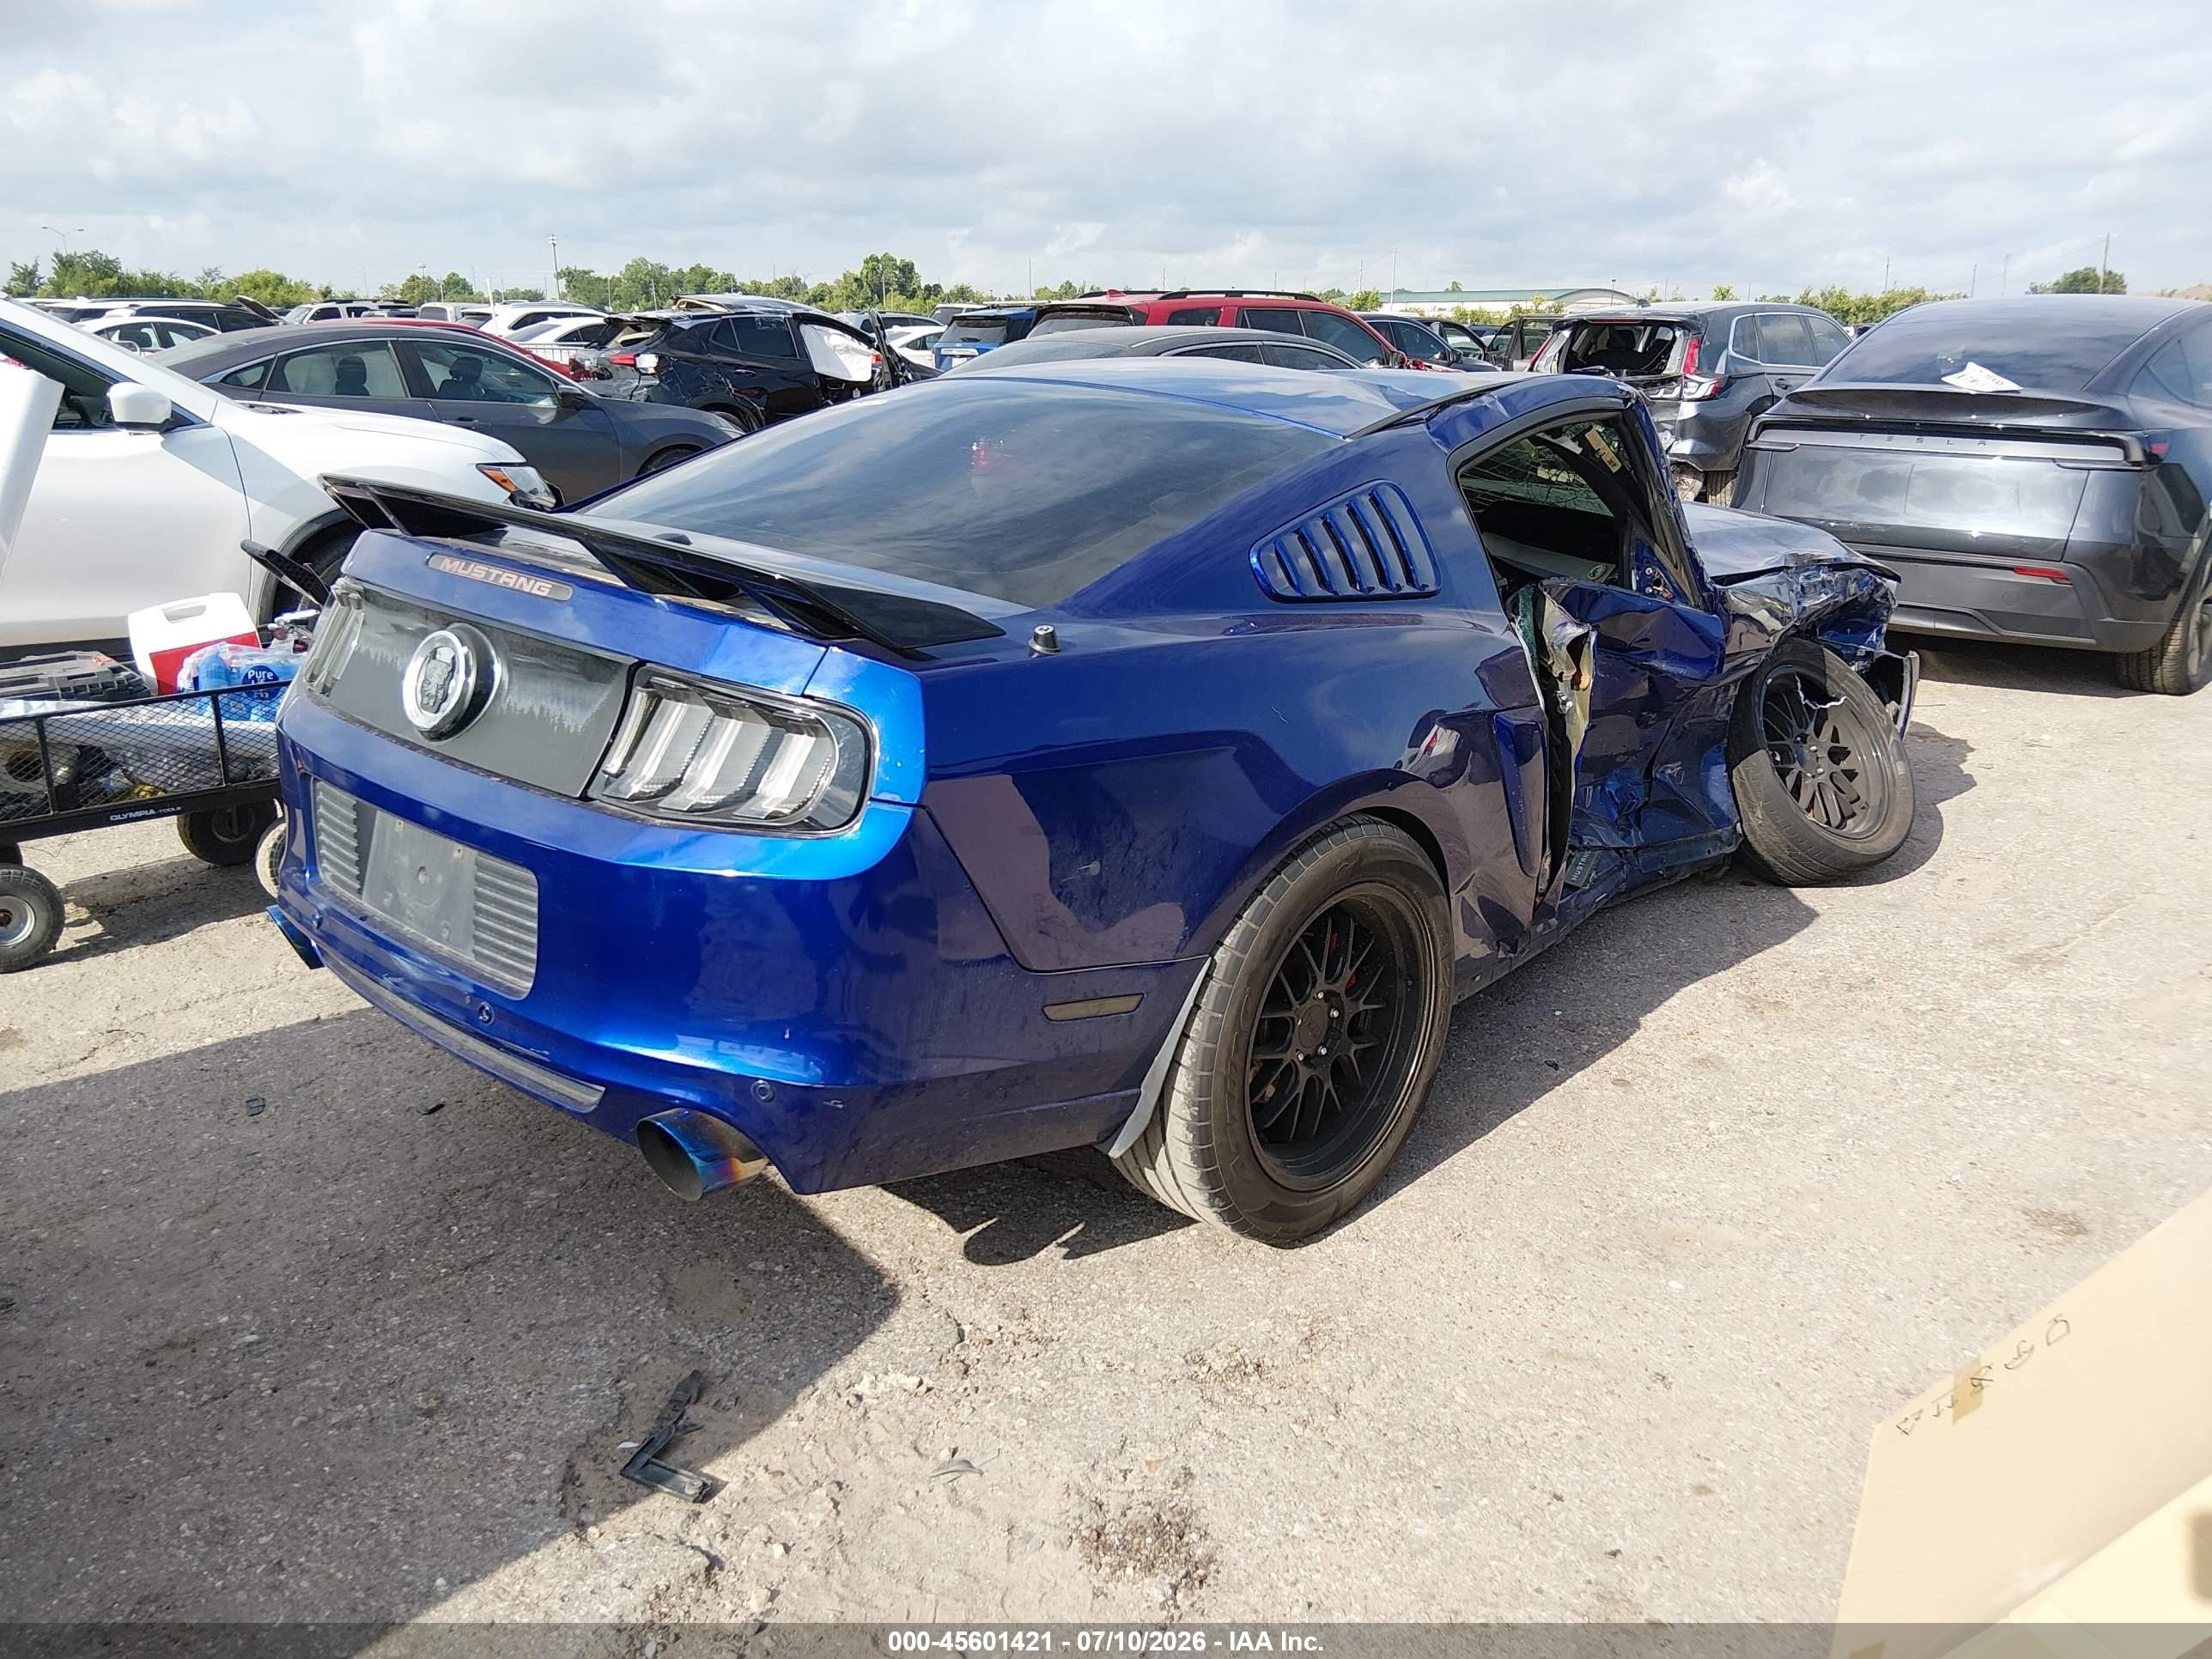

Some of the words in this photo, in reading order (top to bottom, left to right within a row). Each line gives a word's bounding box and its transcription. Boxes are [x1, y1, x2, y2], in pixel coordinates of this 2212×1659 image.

[1858, 434, 1986, 447] TESLA
[439, 558, 552, 596] MUSTANG
[247, 669, 274, 680] Pure
[109, 809, 156, 821] OLYMPIA
